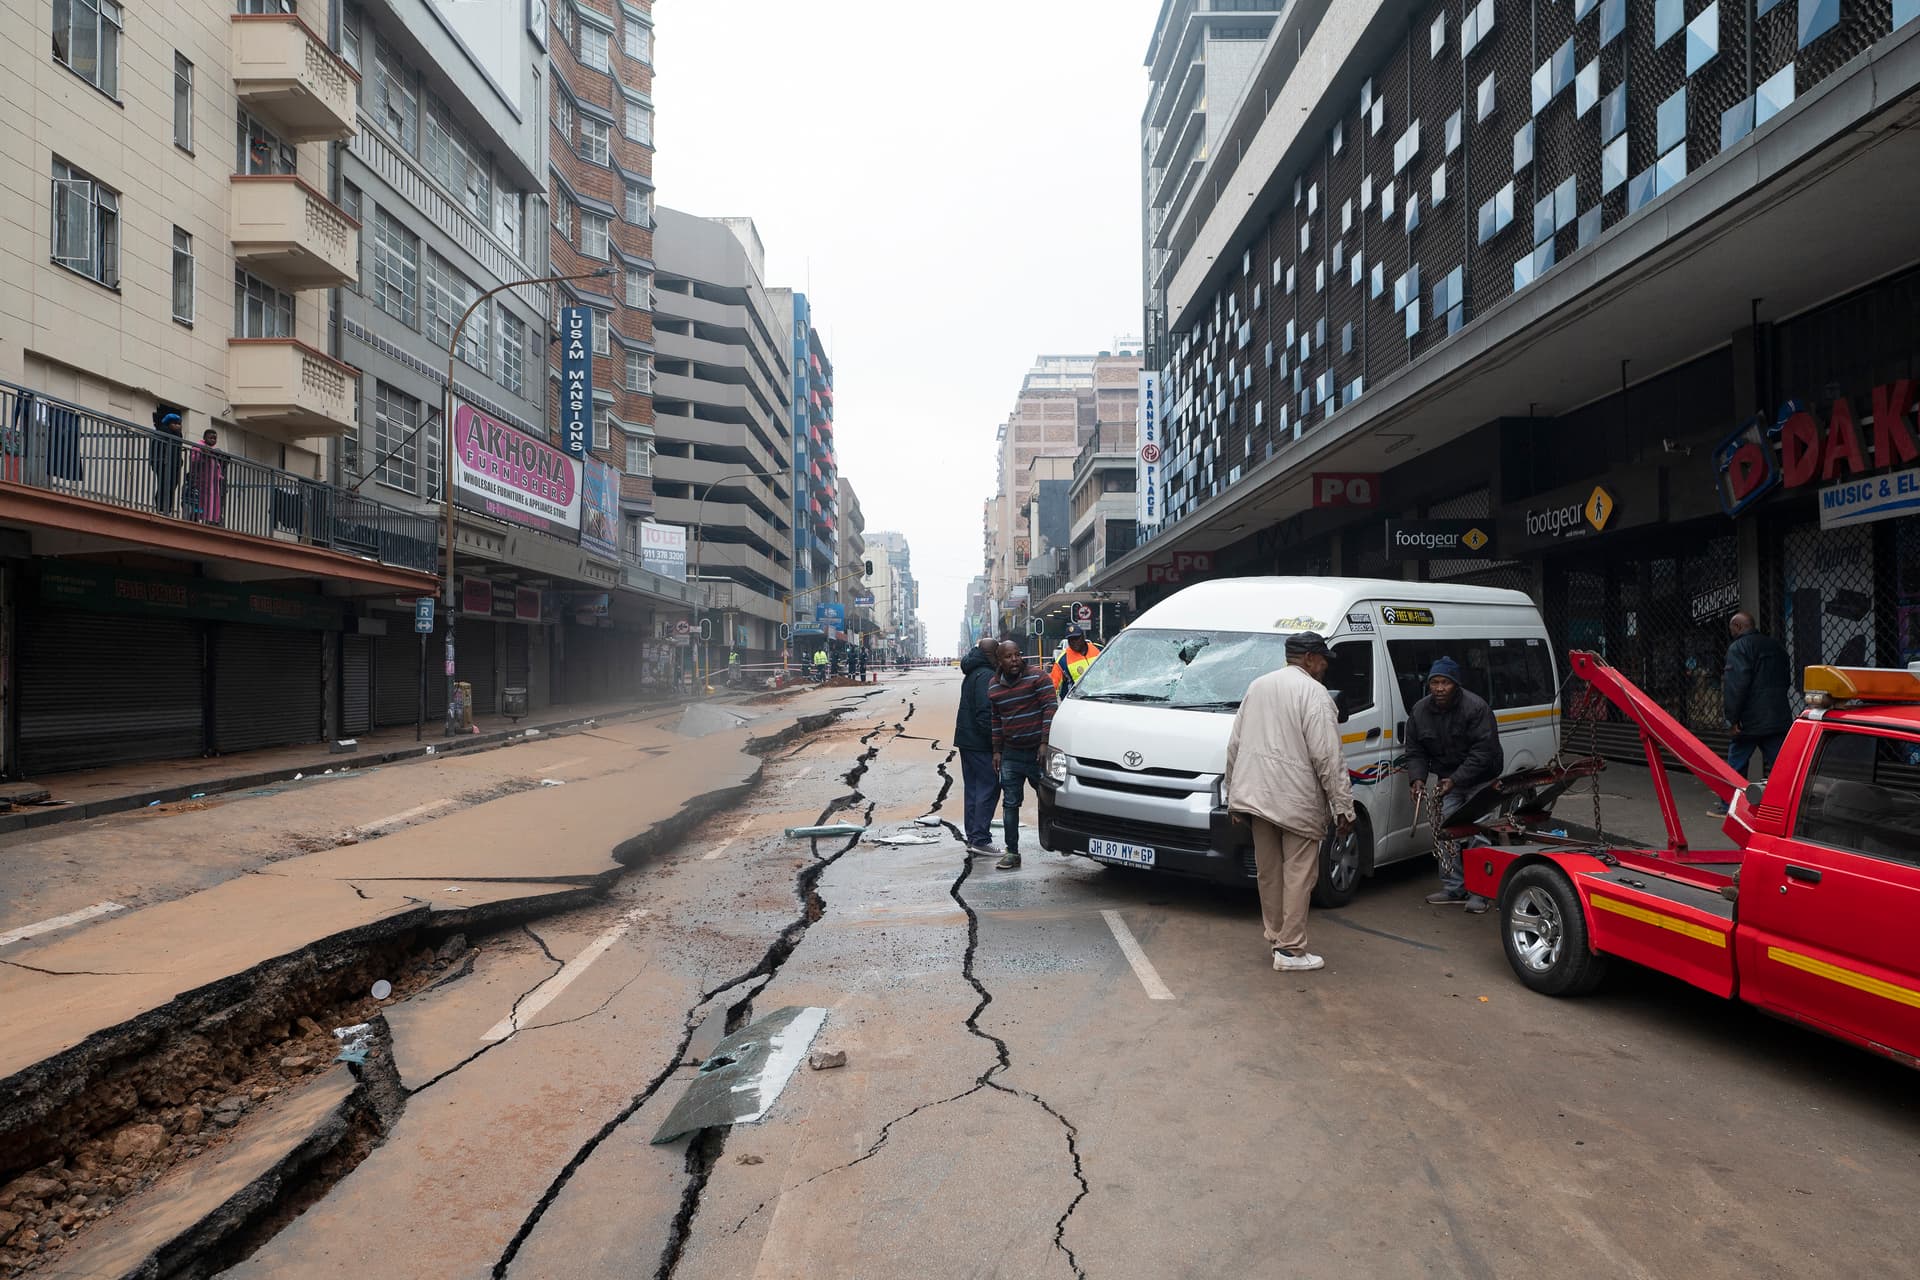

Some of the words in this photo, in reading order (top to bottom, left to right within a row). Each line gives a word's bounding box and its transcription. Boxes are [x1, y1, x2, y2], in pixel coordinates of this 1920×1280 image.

[569, 309, 584, 359] LUSAM
[569, 370, 584, 451] MANSIONS
[1146, 379, 1154, 441] FRANKS
[465, 413, 568, 488] AKHONA
[1780, 378, 1920, 489] DAK
[463, 470, 497, 495] WHOLESALE
[497, 485, 524, 505] FURNITURE
[529, 498, 553, 515] APPLIANCE
[553, 507, 567, 520] STORE
[465, 449, 567, 502] FURNISHERS
[1147, 466, 1155, 516] PLACE
[1320, 478, 1371, 504] PQ
[1823, 482, 1873, 510] MUSIC
[1878, 478, 1891, 499] &
[645, 528, 660, 543] TO
[663, 530, 683, 545] LET
[1395, 530, 1459, 549] footgear
[1526, 502, 1583, 537] footgear
[1178, 555, 1209, 571] PQ
[420, 606, 429, 617] R
[1091, 840, 1102, 854] JH
[1105, 843, 1118, 857] 89
[1140, 848, 1153, 862] GP
